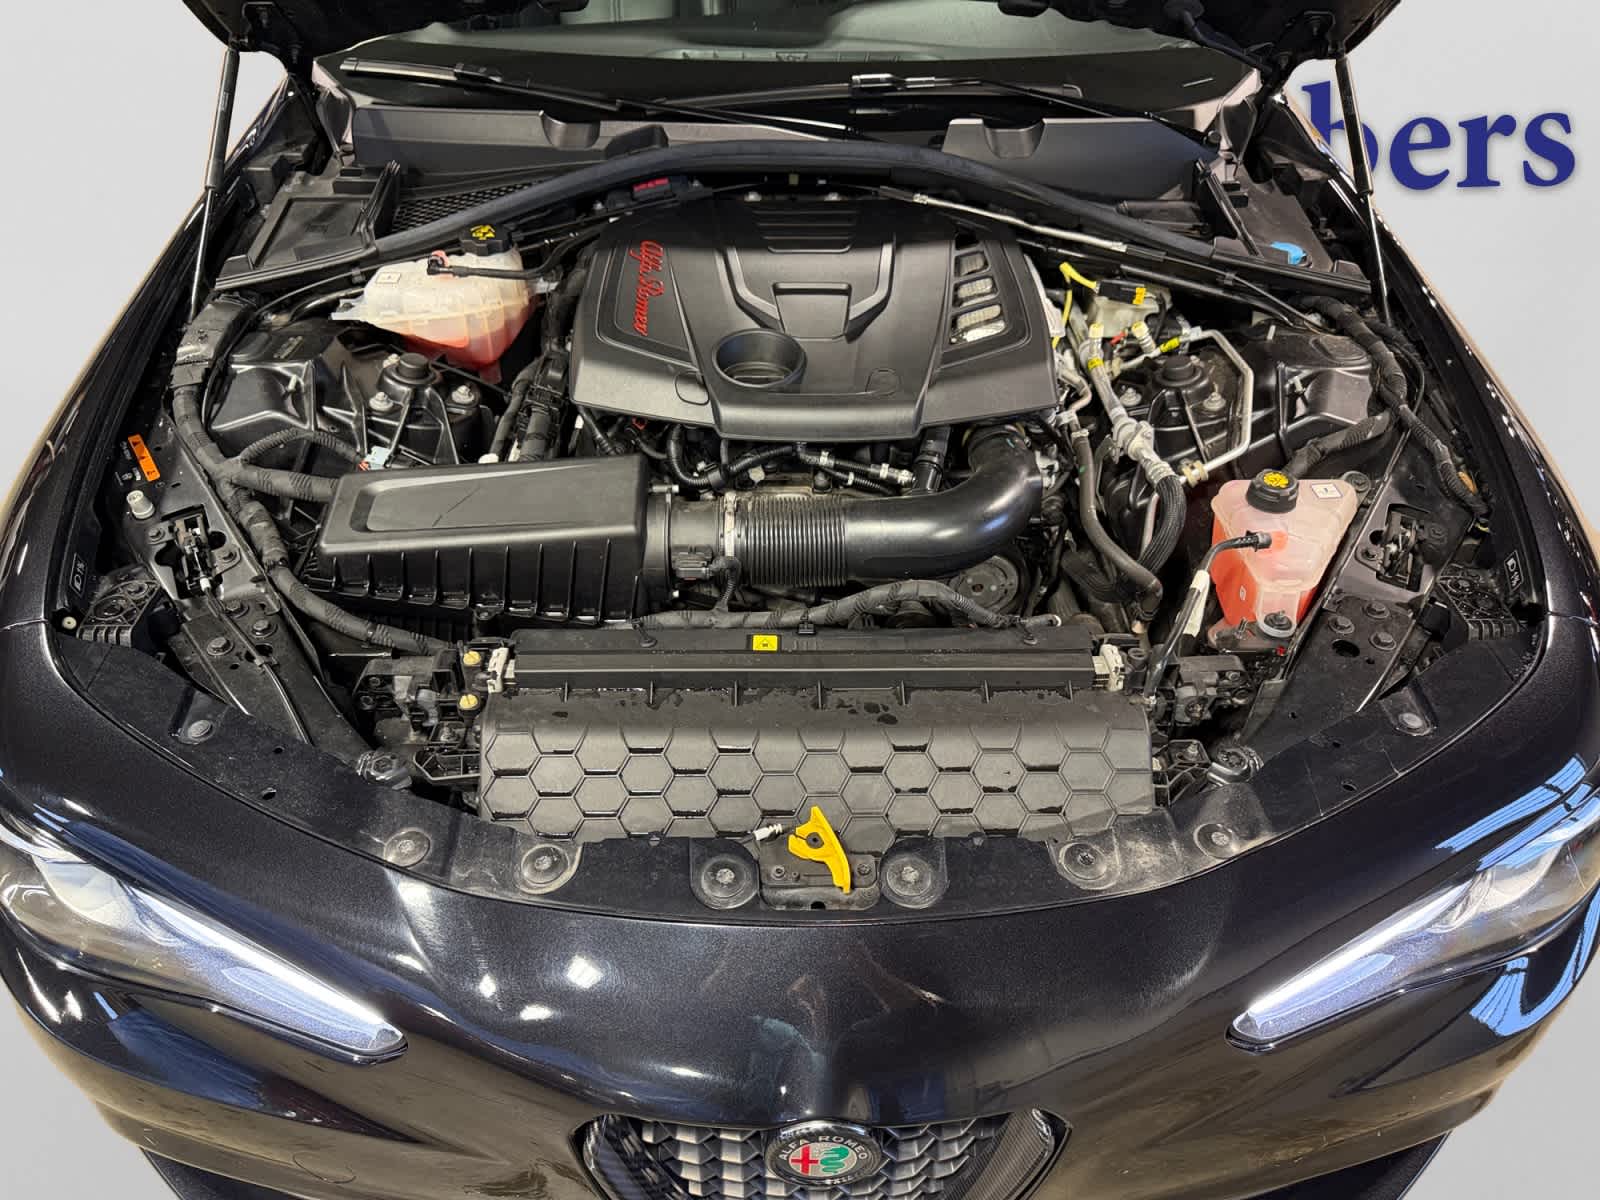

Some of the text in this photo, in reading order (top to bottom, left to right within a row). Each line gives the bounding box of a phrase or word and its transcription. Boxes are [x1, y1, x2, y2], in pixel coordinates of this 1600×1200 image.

[629, 239, 665, 336] Alfa Romeo
[778, 1135, 869, 1161] ALFA ROMEO
